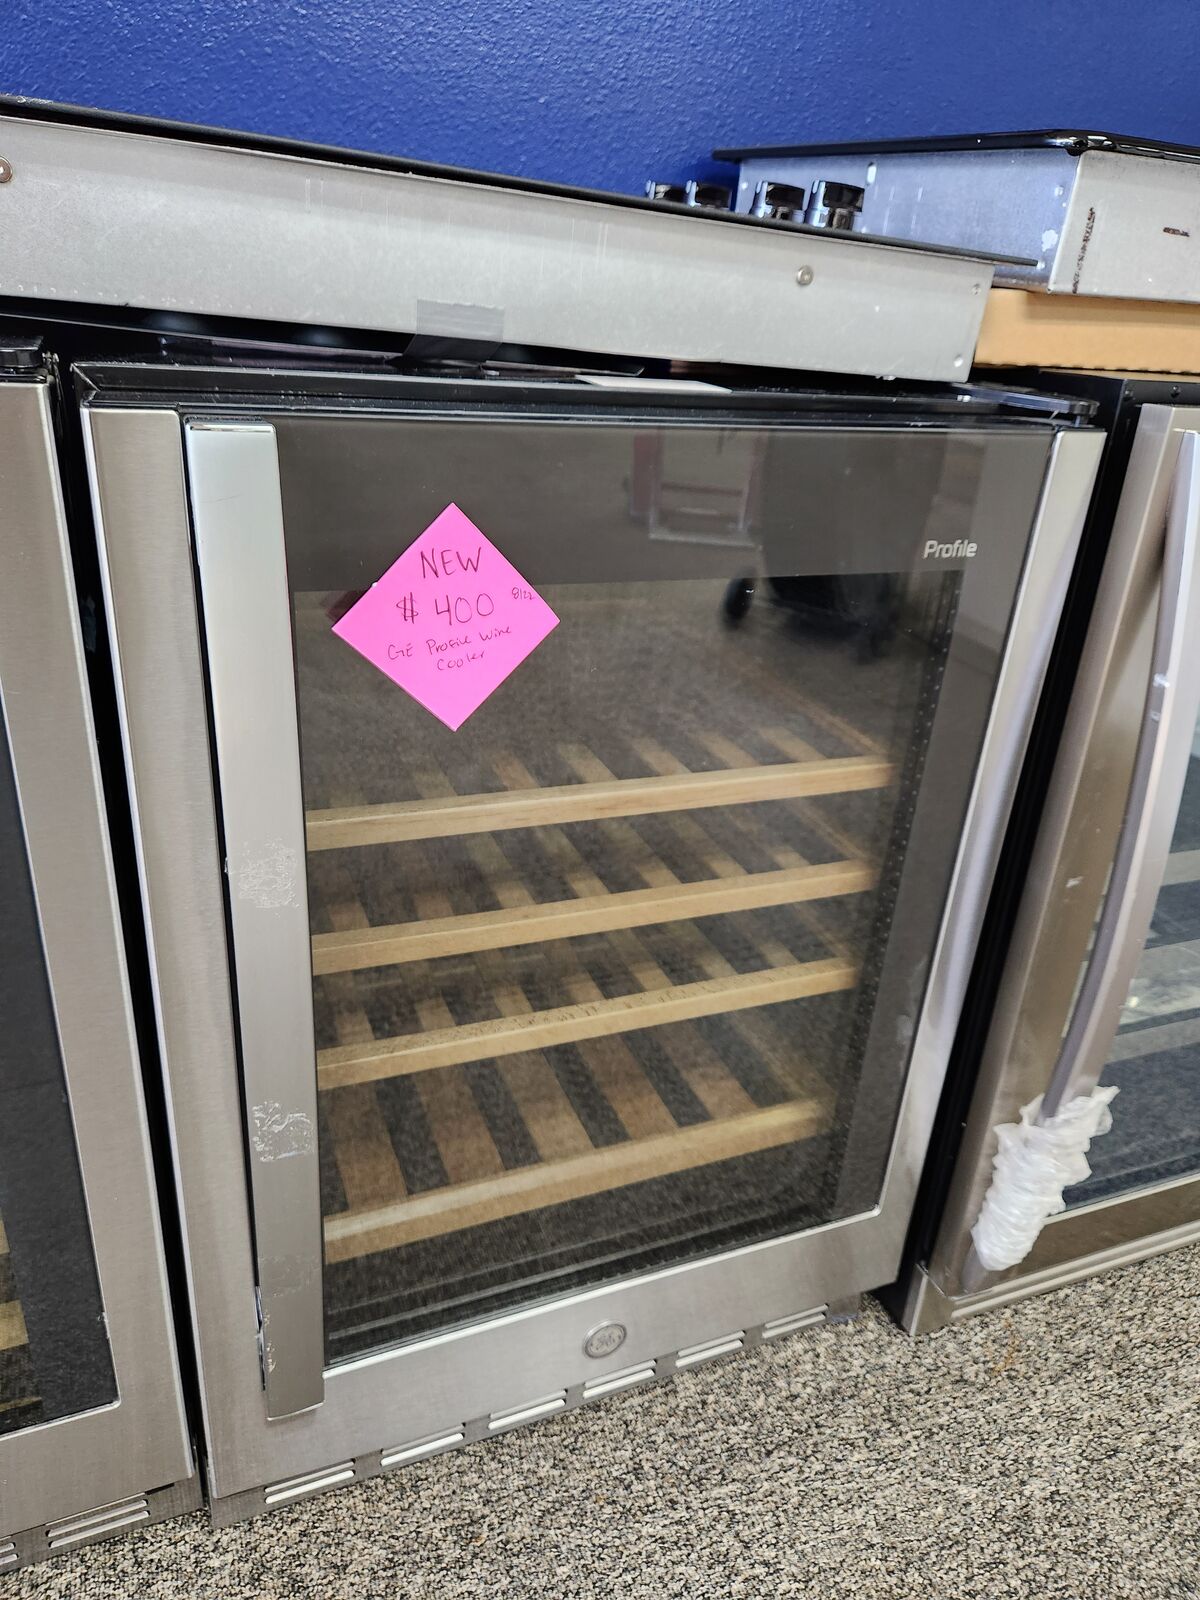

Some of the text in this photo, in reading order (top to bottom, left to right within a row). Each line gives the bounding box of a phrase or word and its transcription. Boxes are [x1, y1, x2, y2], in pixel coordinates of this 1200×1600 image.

[420, 547, 482, 579] NEW
[922, 539, 978, 559] Profile
[434, 593, 495, 626] 400
[387, 643, 414, 661] GE
[478, 626, 512, 641] Wine
[436, 651, 485, 671] Cooler
